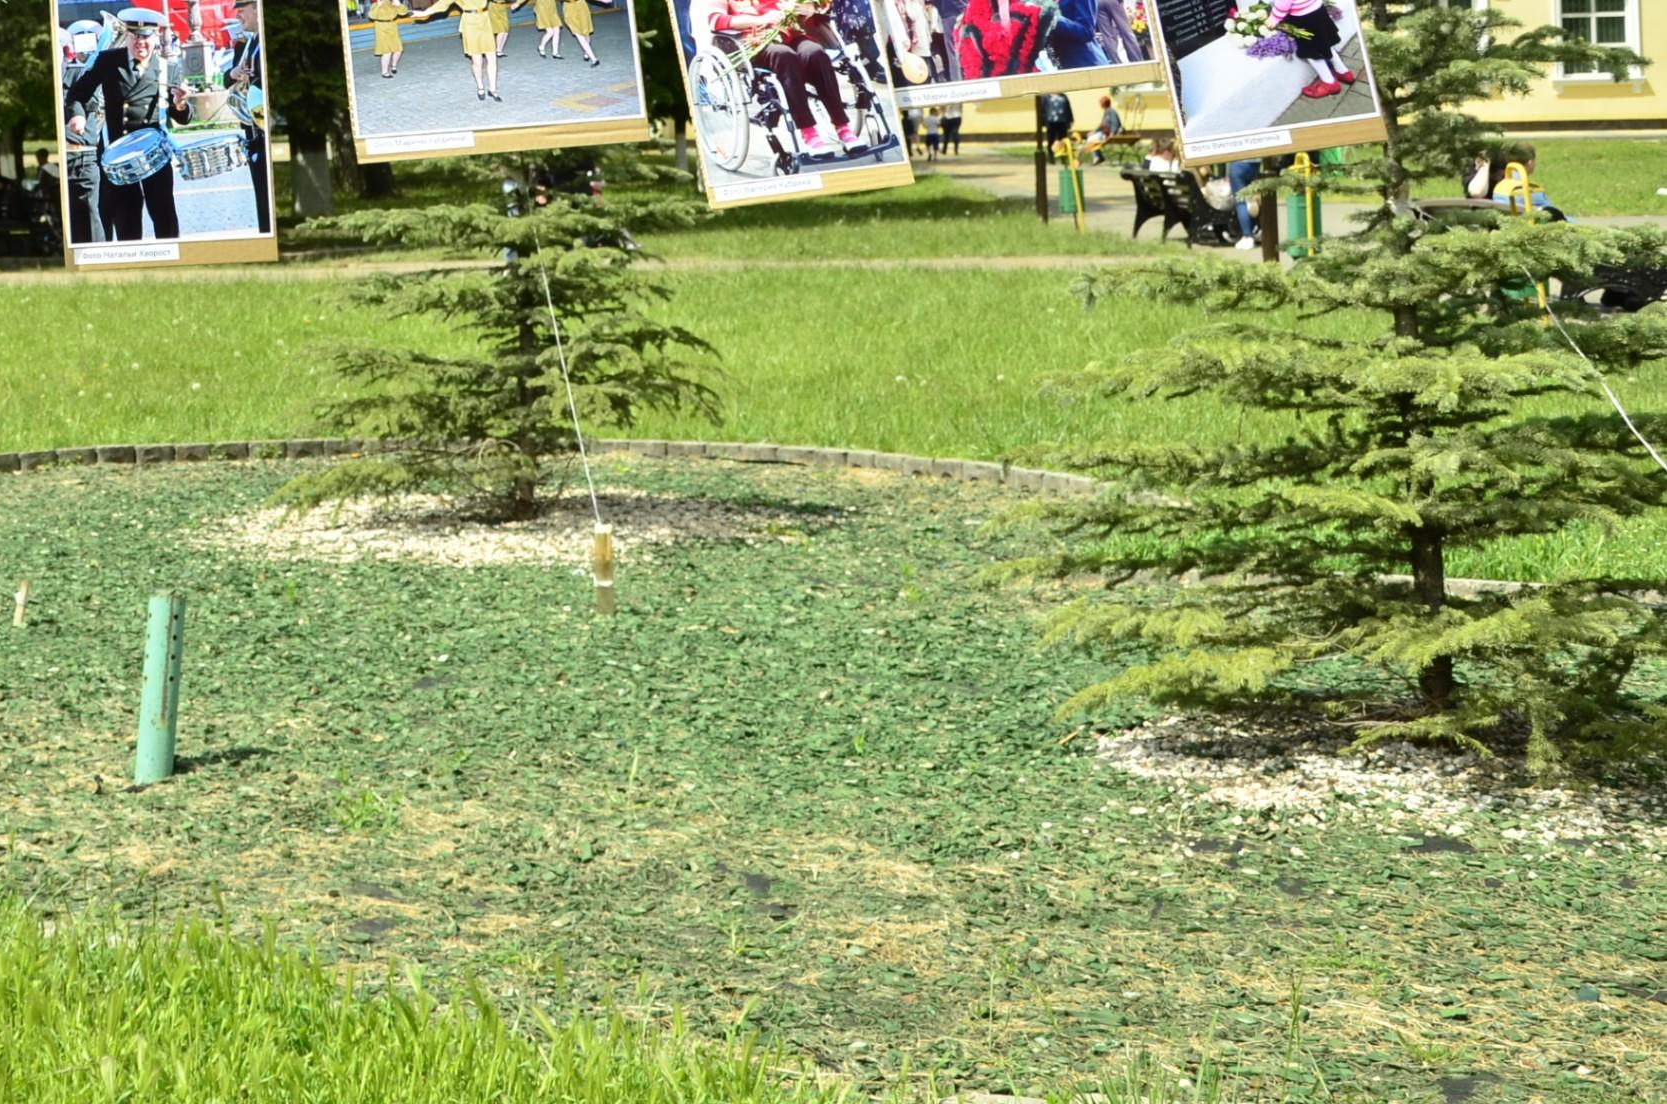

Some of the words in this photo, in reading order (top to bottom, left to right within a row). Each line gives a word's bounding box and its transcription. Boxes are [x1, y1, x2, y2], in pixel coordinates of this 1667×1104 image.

[1190, 143, 1210, 152] Фото
[83, 251, 102, 260] Фото
[103, 250, 137, 259] Натальи
[139, 249, 171, 259] Хворост
